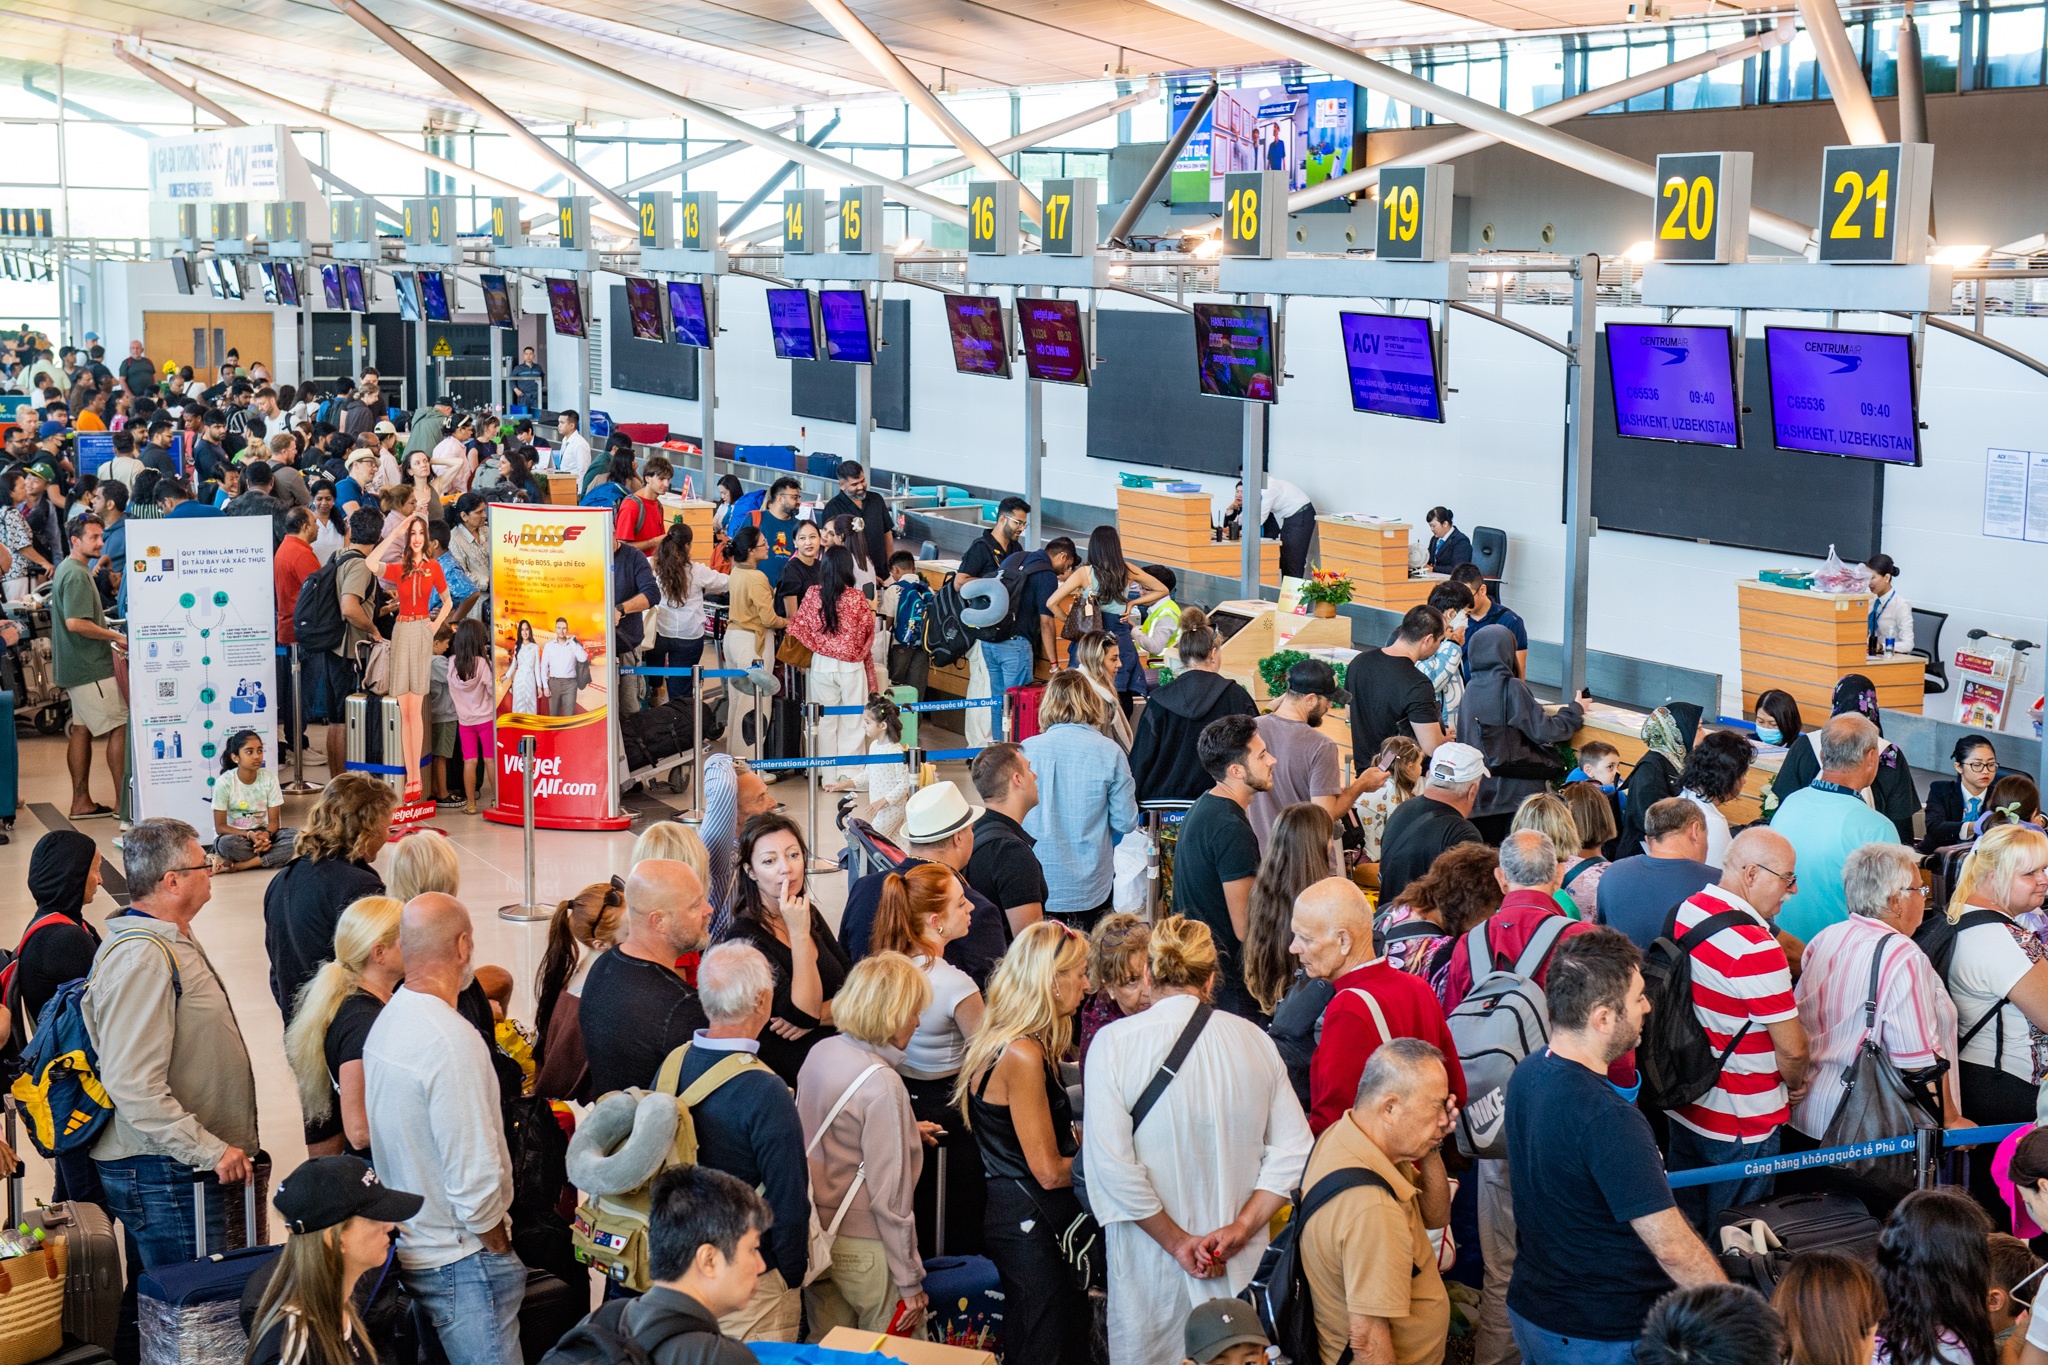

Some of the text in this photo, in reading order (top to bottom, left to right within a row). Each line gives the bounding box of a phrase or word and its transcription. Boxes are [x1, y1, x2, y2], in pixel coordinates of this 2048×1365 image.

[225, 145, 248, 187] ACV
[971, 196, 995, 240] 16
[1046, 195, 1070, 240] 17
[1228, 189, 1258, 241] 18
[1383, 185, 1418, 242] 19
[1659, 175, 1715, 241] 20
[1830, 169, 1889, 240] 21
[286, 208, 293, 235] 5
[332, 207, 338, 235] 6
[355, 206, 360, 234] 7
[405, 207, 412, 237] 8
[432, 206, 439, 238] 9
[492, 207, 504, 237] 10
[561, 207, 573, 239] 11
[640, 203, 655, 237] 12
[684, 203, 699, 238] 13
[786, 203, 803, 240] 14
[842, 200, 860, 240] 15
[1055, 346, 1070, 357] MINH
[1353, 333, 1380, 355] ACV
[1640, 336, 1689, 347] CENTRUMAIR
[1805, 341, 1862, 355] CENTRUMAIR
[1626, 387, 1715, 405] C65536 09:40
[1787, 395, 1890, 418] C65536 09:40
[1619, 413, 1735, 435] TASHKENT, UZBEKISTAN
[1777, 424, 1912, 451] TASHKENT, UZBEKISTAN
[236, 546, 249, 554] THỦ
[200, 566, 218, 574] TRẮC
[810, 759, 836, 768] Airport
[1468, 1086, 1505, 1130] NIKE
[1774, 1157, 1799, 1169] hàng
[1863, 1143, 1873, 1156] tế
[1875, 1140, 1895, 1153] Phú
